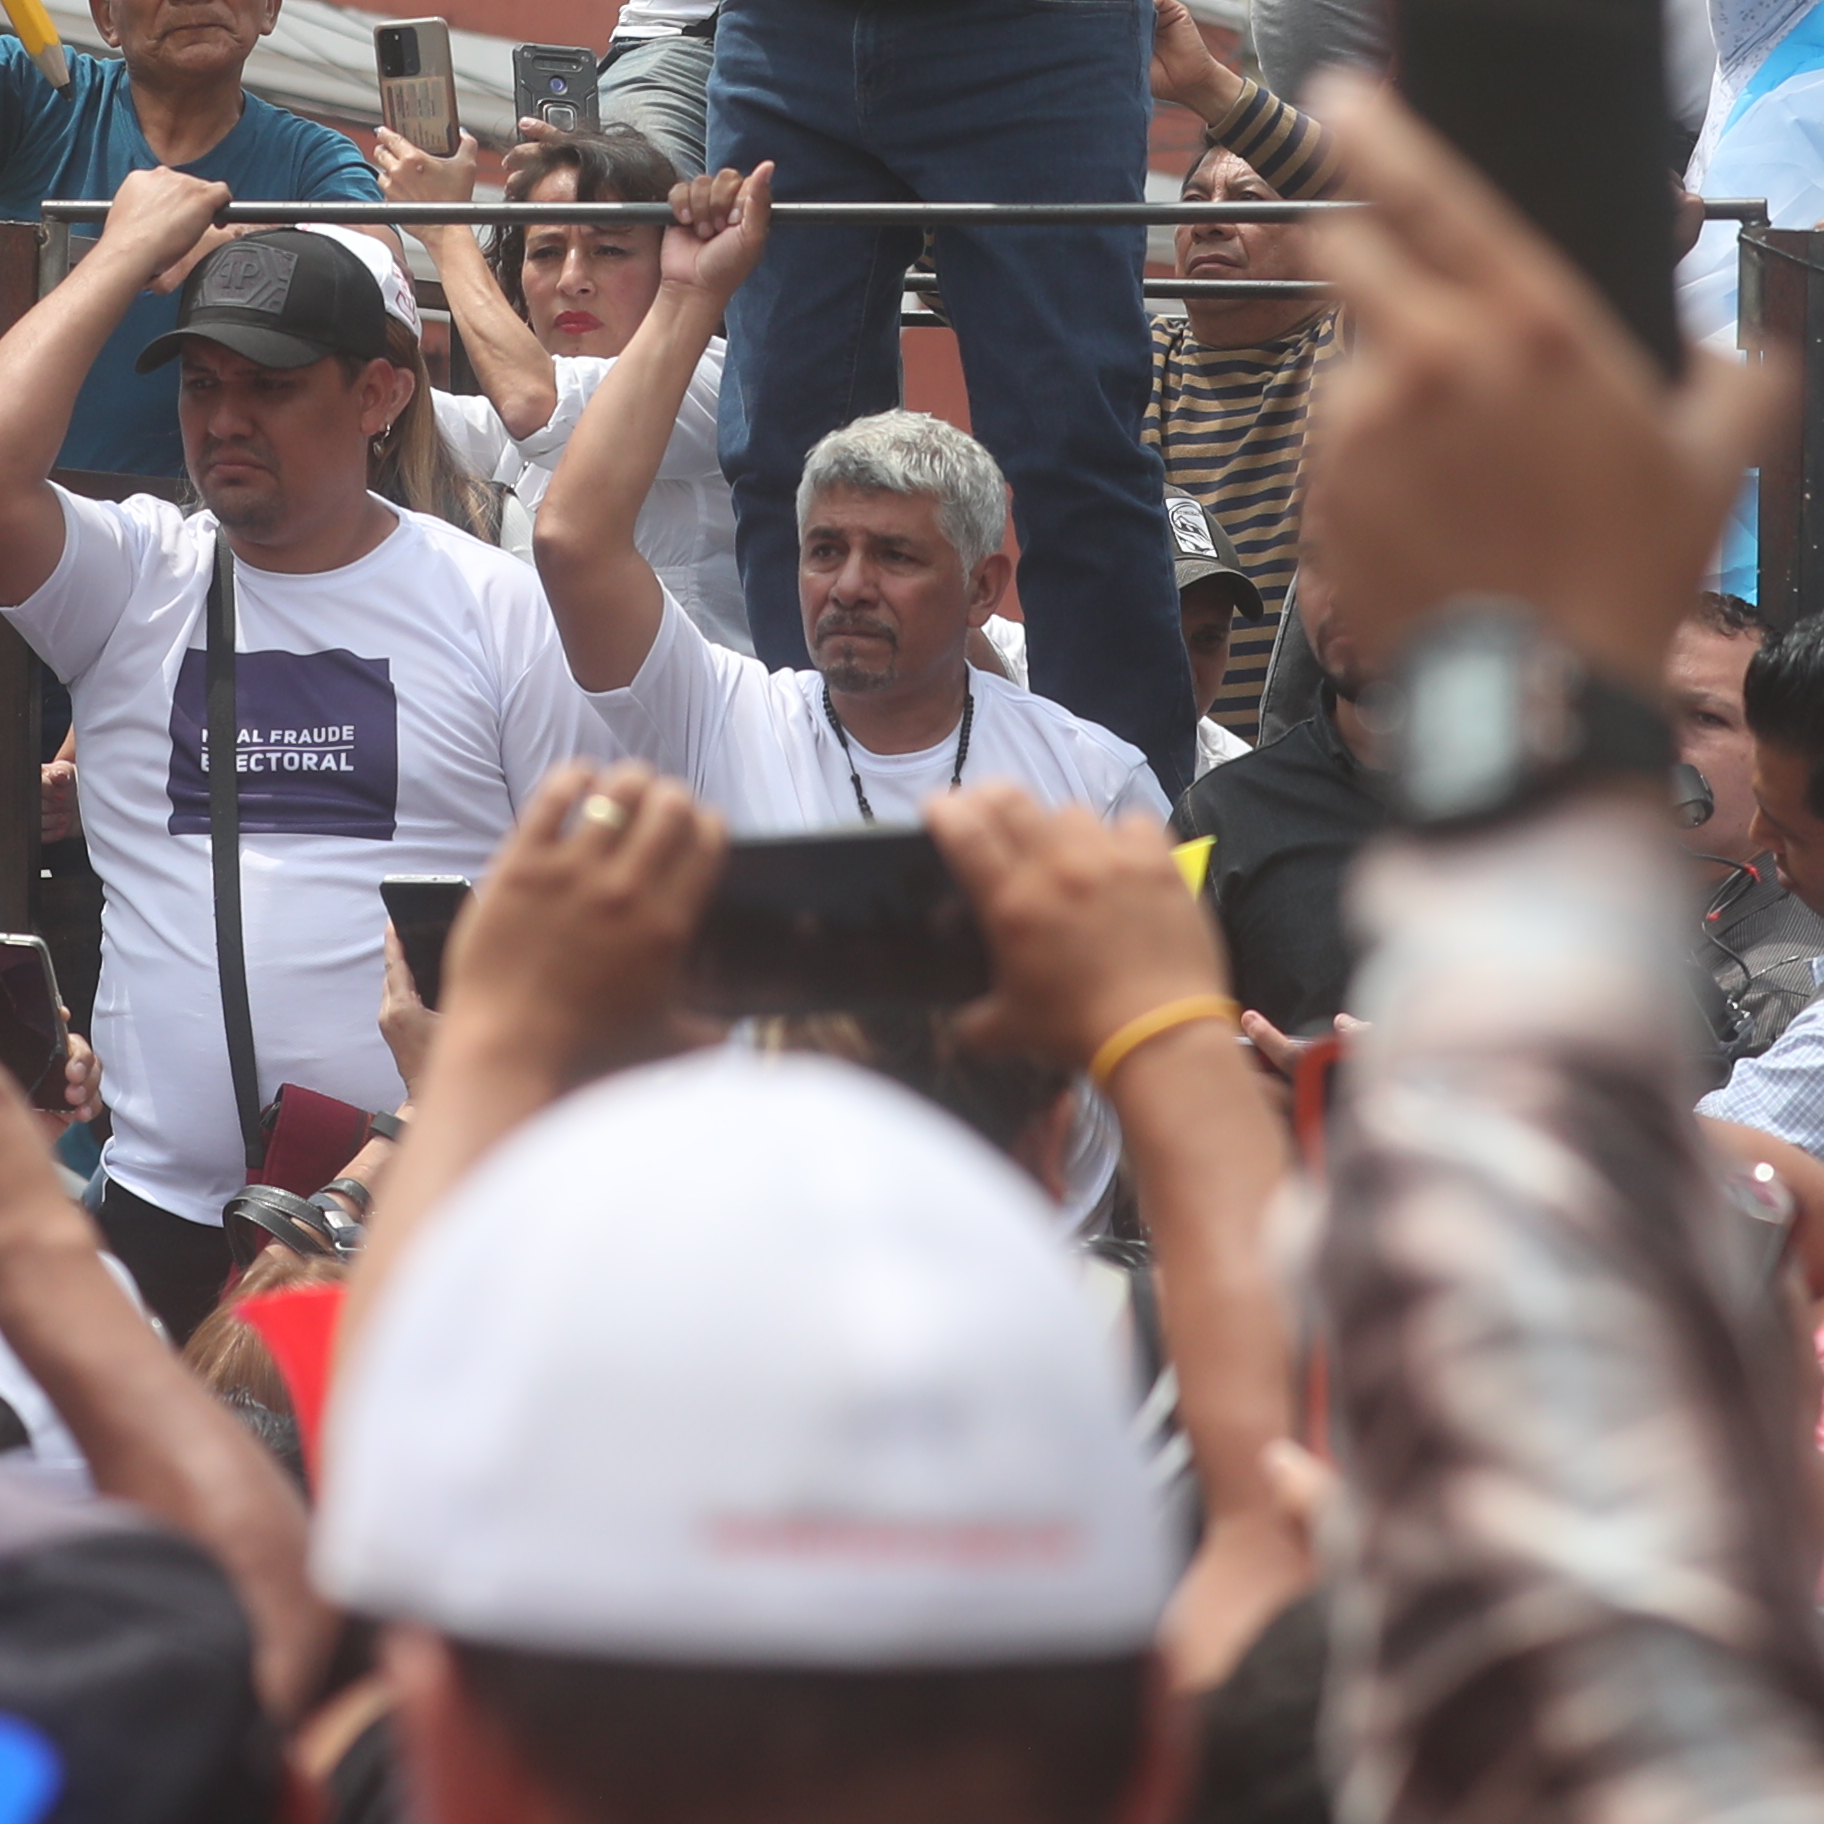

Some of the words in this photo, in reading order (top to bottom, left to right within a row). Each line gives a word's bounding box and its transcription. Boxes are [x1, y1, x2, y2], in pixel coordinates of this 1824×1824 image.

[236, 728, 264, 744] AL
[269, 725, 355, 744] FRAUDE
[200, 752, 355, 773] EECTORAL
